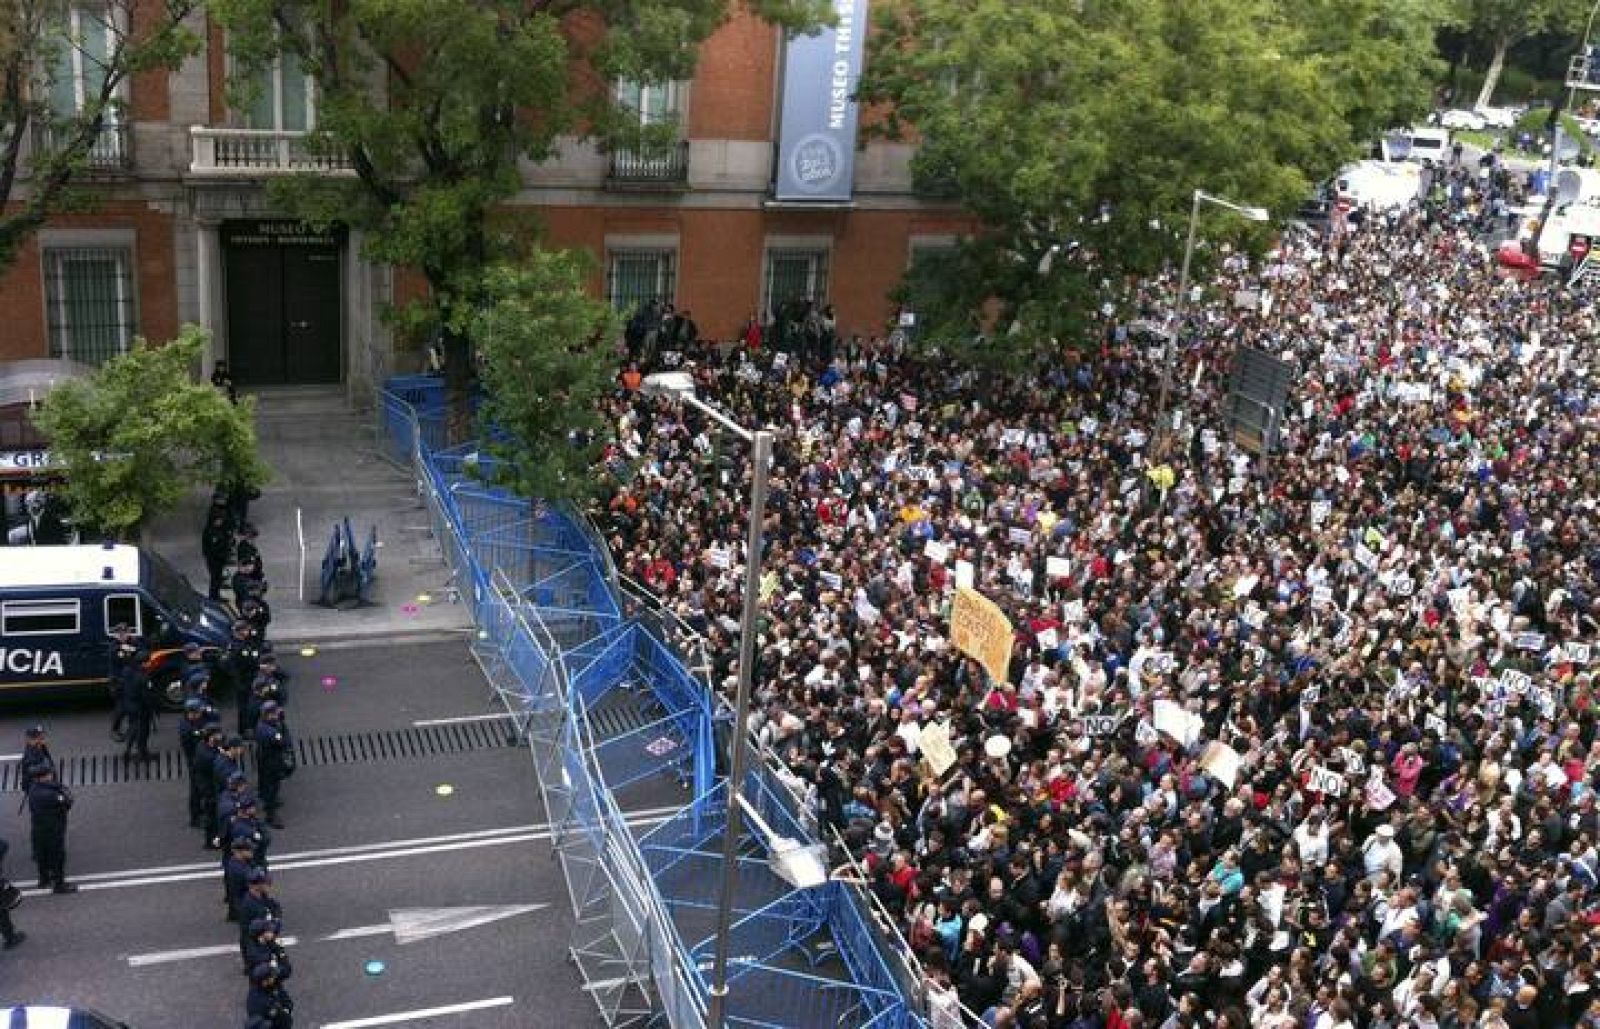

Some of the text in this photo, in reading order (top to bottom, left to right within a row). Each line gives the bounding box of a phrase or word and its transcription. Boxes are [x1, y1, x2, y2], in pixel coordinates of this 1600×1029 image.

[830, 60, 849, 129] MUSEO
[1566, 644, 1588, 661] NO
[1504, 669, 1529, 691] NO
[1086, 717, 1114, 735] NO
[1311, 769, 1339, 796] NO
